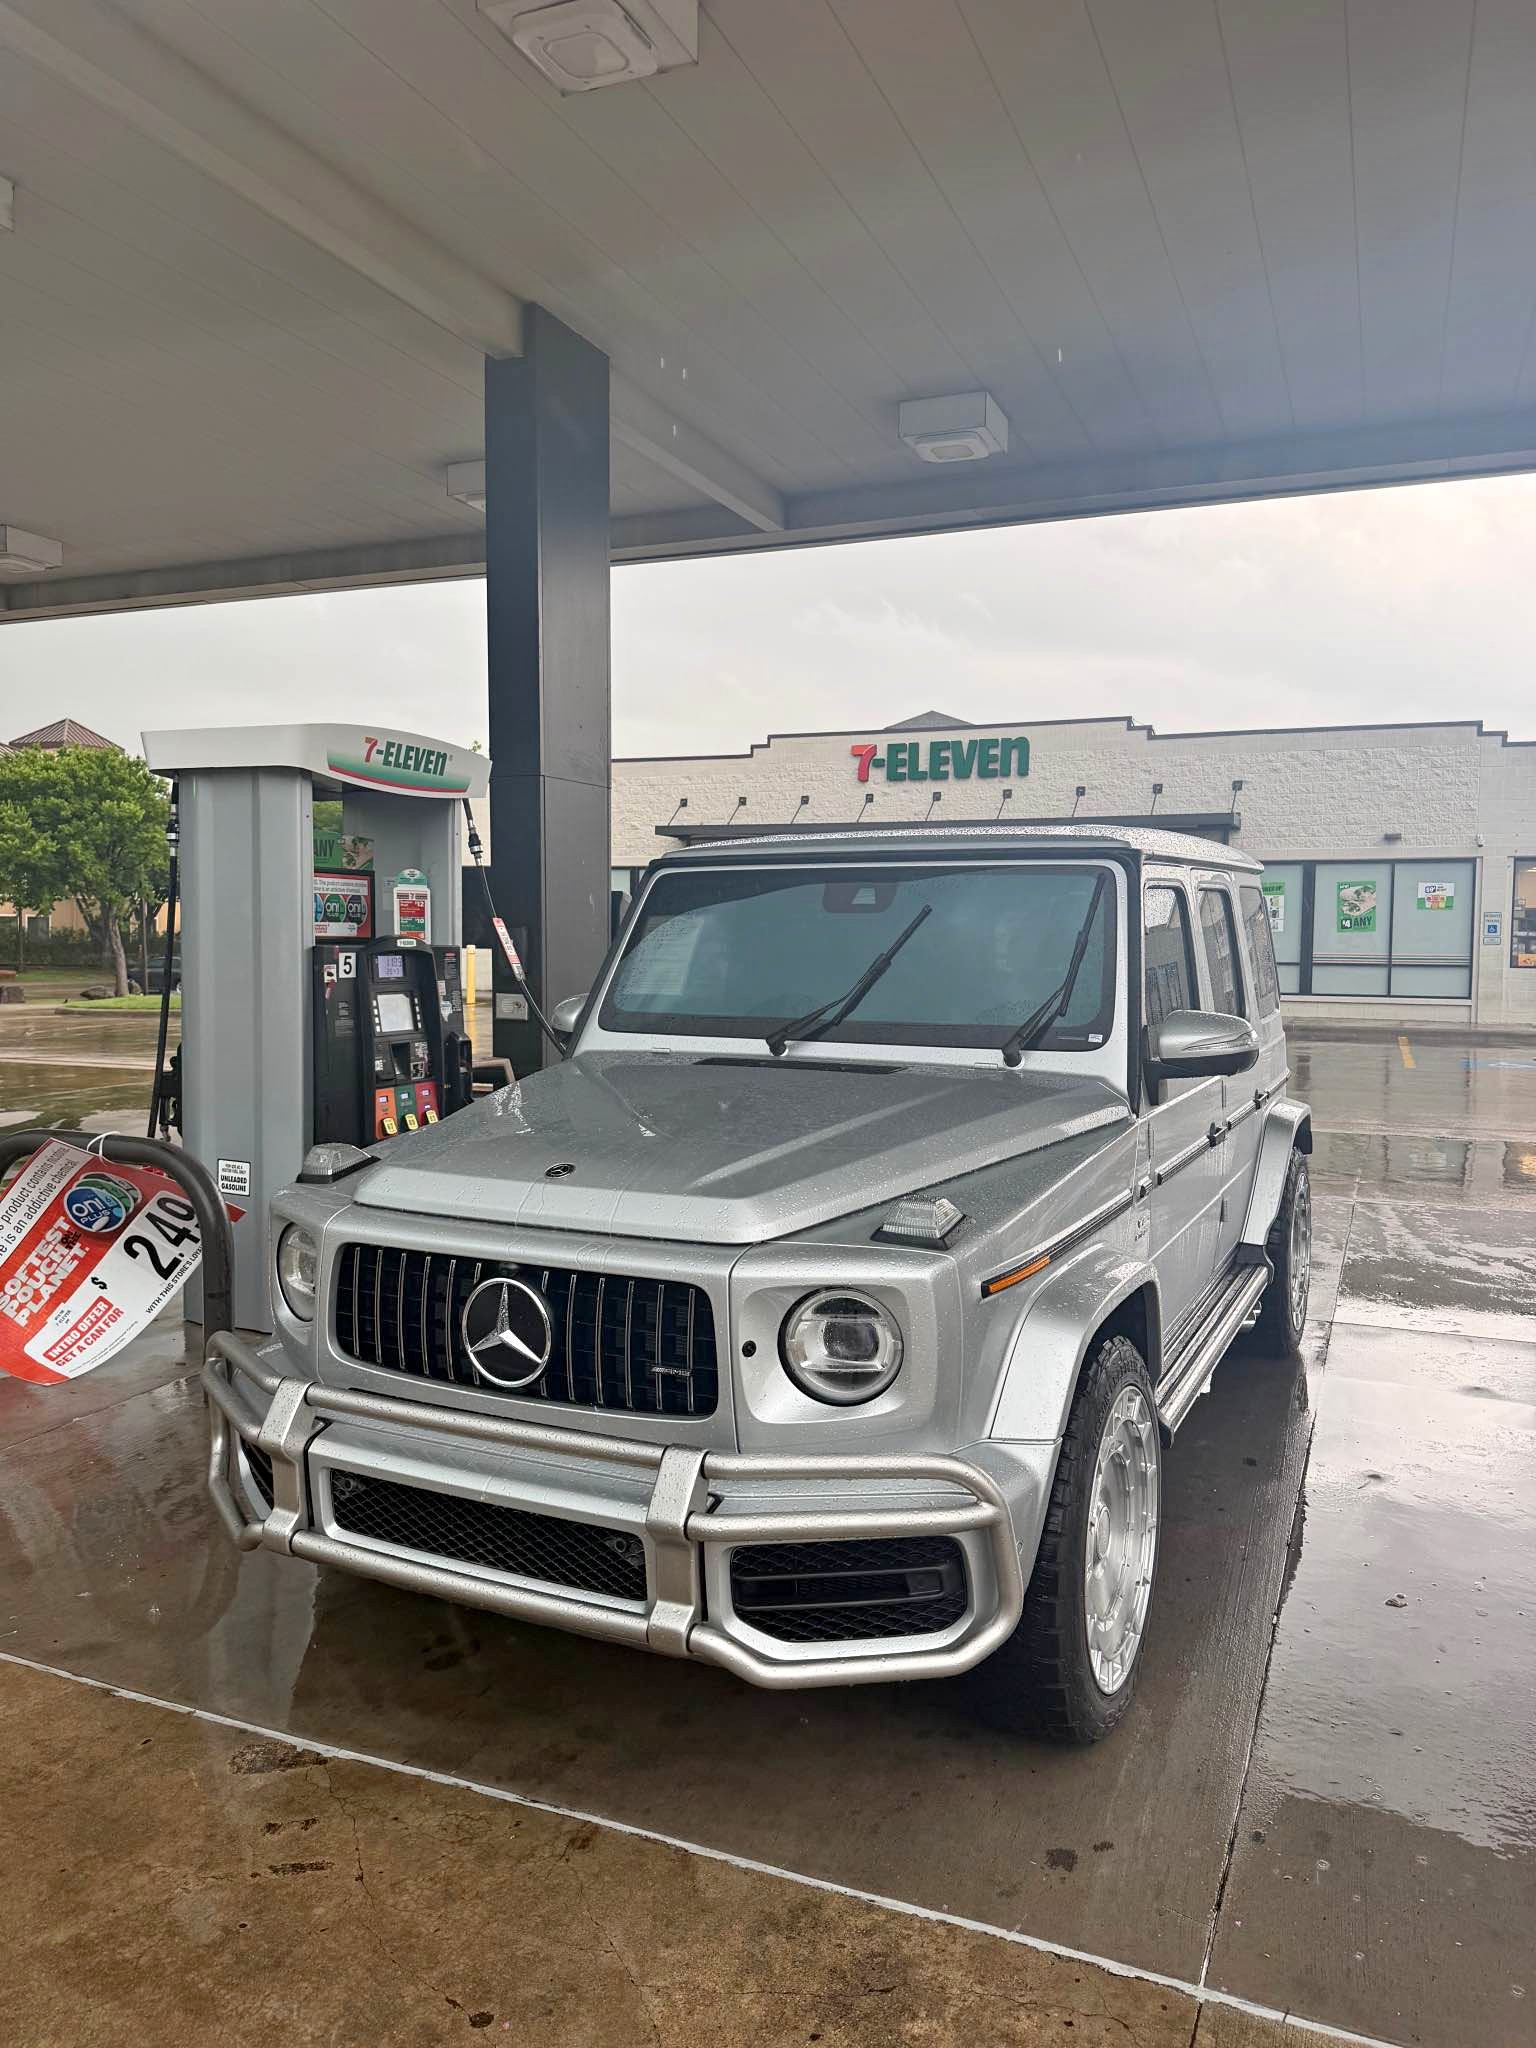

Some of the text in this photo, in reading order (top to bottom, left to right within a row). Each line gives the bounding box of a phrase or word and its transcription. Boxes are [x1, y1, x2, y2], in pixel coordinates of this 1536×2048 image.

[343, 955, 353, 975] 5
[1, 1187, 32, 1224] product
[27, 1163, 53, 1188] contains
[220, 1175, 247, 1184] UNLEADED
[221, 1182, 247, 1192] GASOLINE
[1, 1233, 16, 1244] is
[14, 1219, 28, 1233] an
[24, 1182, 57, 1220] addictive
[80, 1209, 110, 1223] PLUS
[0, 1216, 70, 1310] SOFTEST
[3, 1243, 69, 1318] POUCH
[14, 1242, 90, 1327] PLANET.
[90, 1276, 108, 1290] $
[146, 1297, 162, 1314] WITH
[160, 1283, 174, 1298] THIS
[171, 1260, 192, 1284] STORE'S
[47, 1329, 80, 1358] INTRO
[78, 1301, 109, 1332] OFFER
[56, 1308, 124, 1366] GET A CAN FOR
